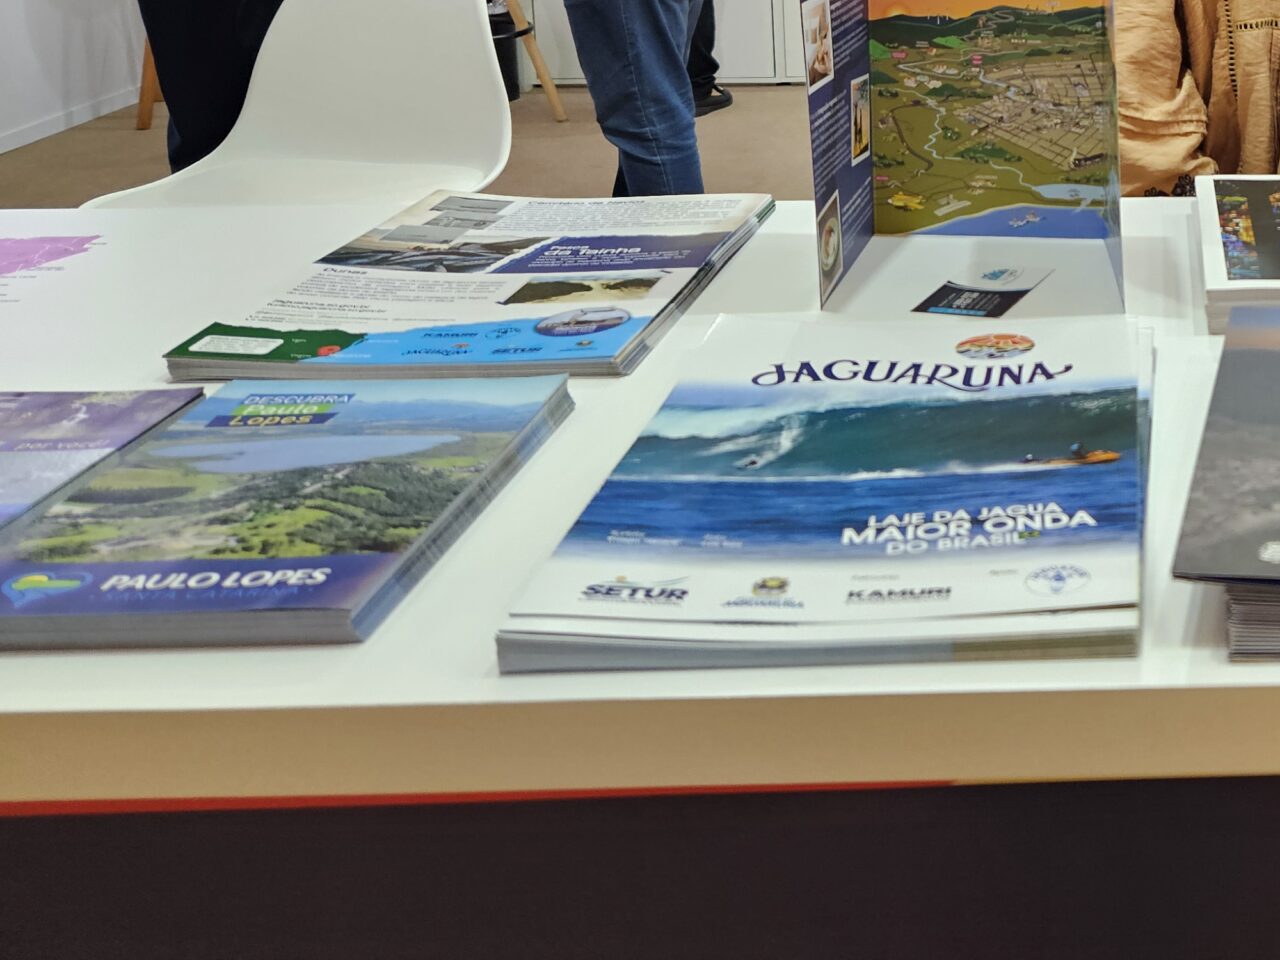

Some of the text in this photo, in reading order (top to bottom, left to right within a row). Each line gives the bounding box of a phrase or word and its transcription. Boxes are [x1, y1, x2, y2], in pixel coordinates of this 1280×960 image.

[751, 359, 1073, 392] JAGUARUNA
[243, 395, 349, 404] DESCUBRA
[243, 404, 319, 415] Paulo
[228, 415, 314, 427] Lopes
[867, 502, 1063, 527] LAJE DA JAGUA
[841, 510, 1098, 545] MAIOR ONDA
[886, 531, 1027, 556] DO BRASIL
[100, 567, 333, 591] PAULO LOPES
[581, 583, 689, 601] SETUR
